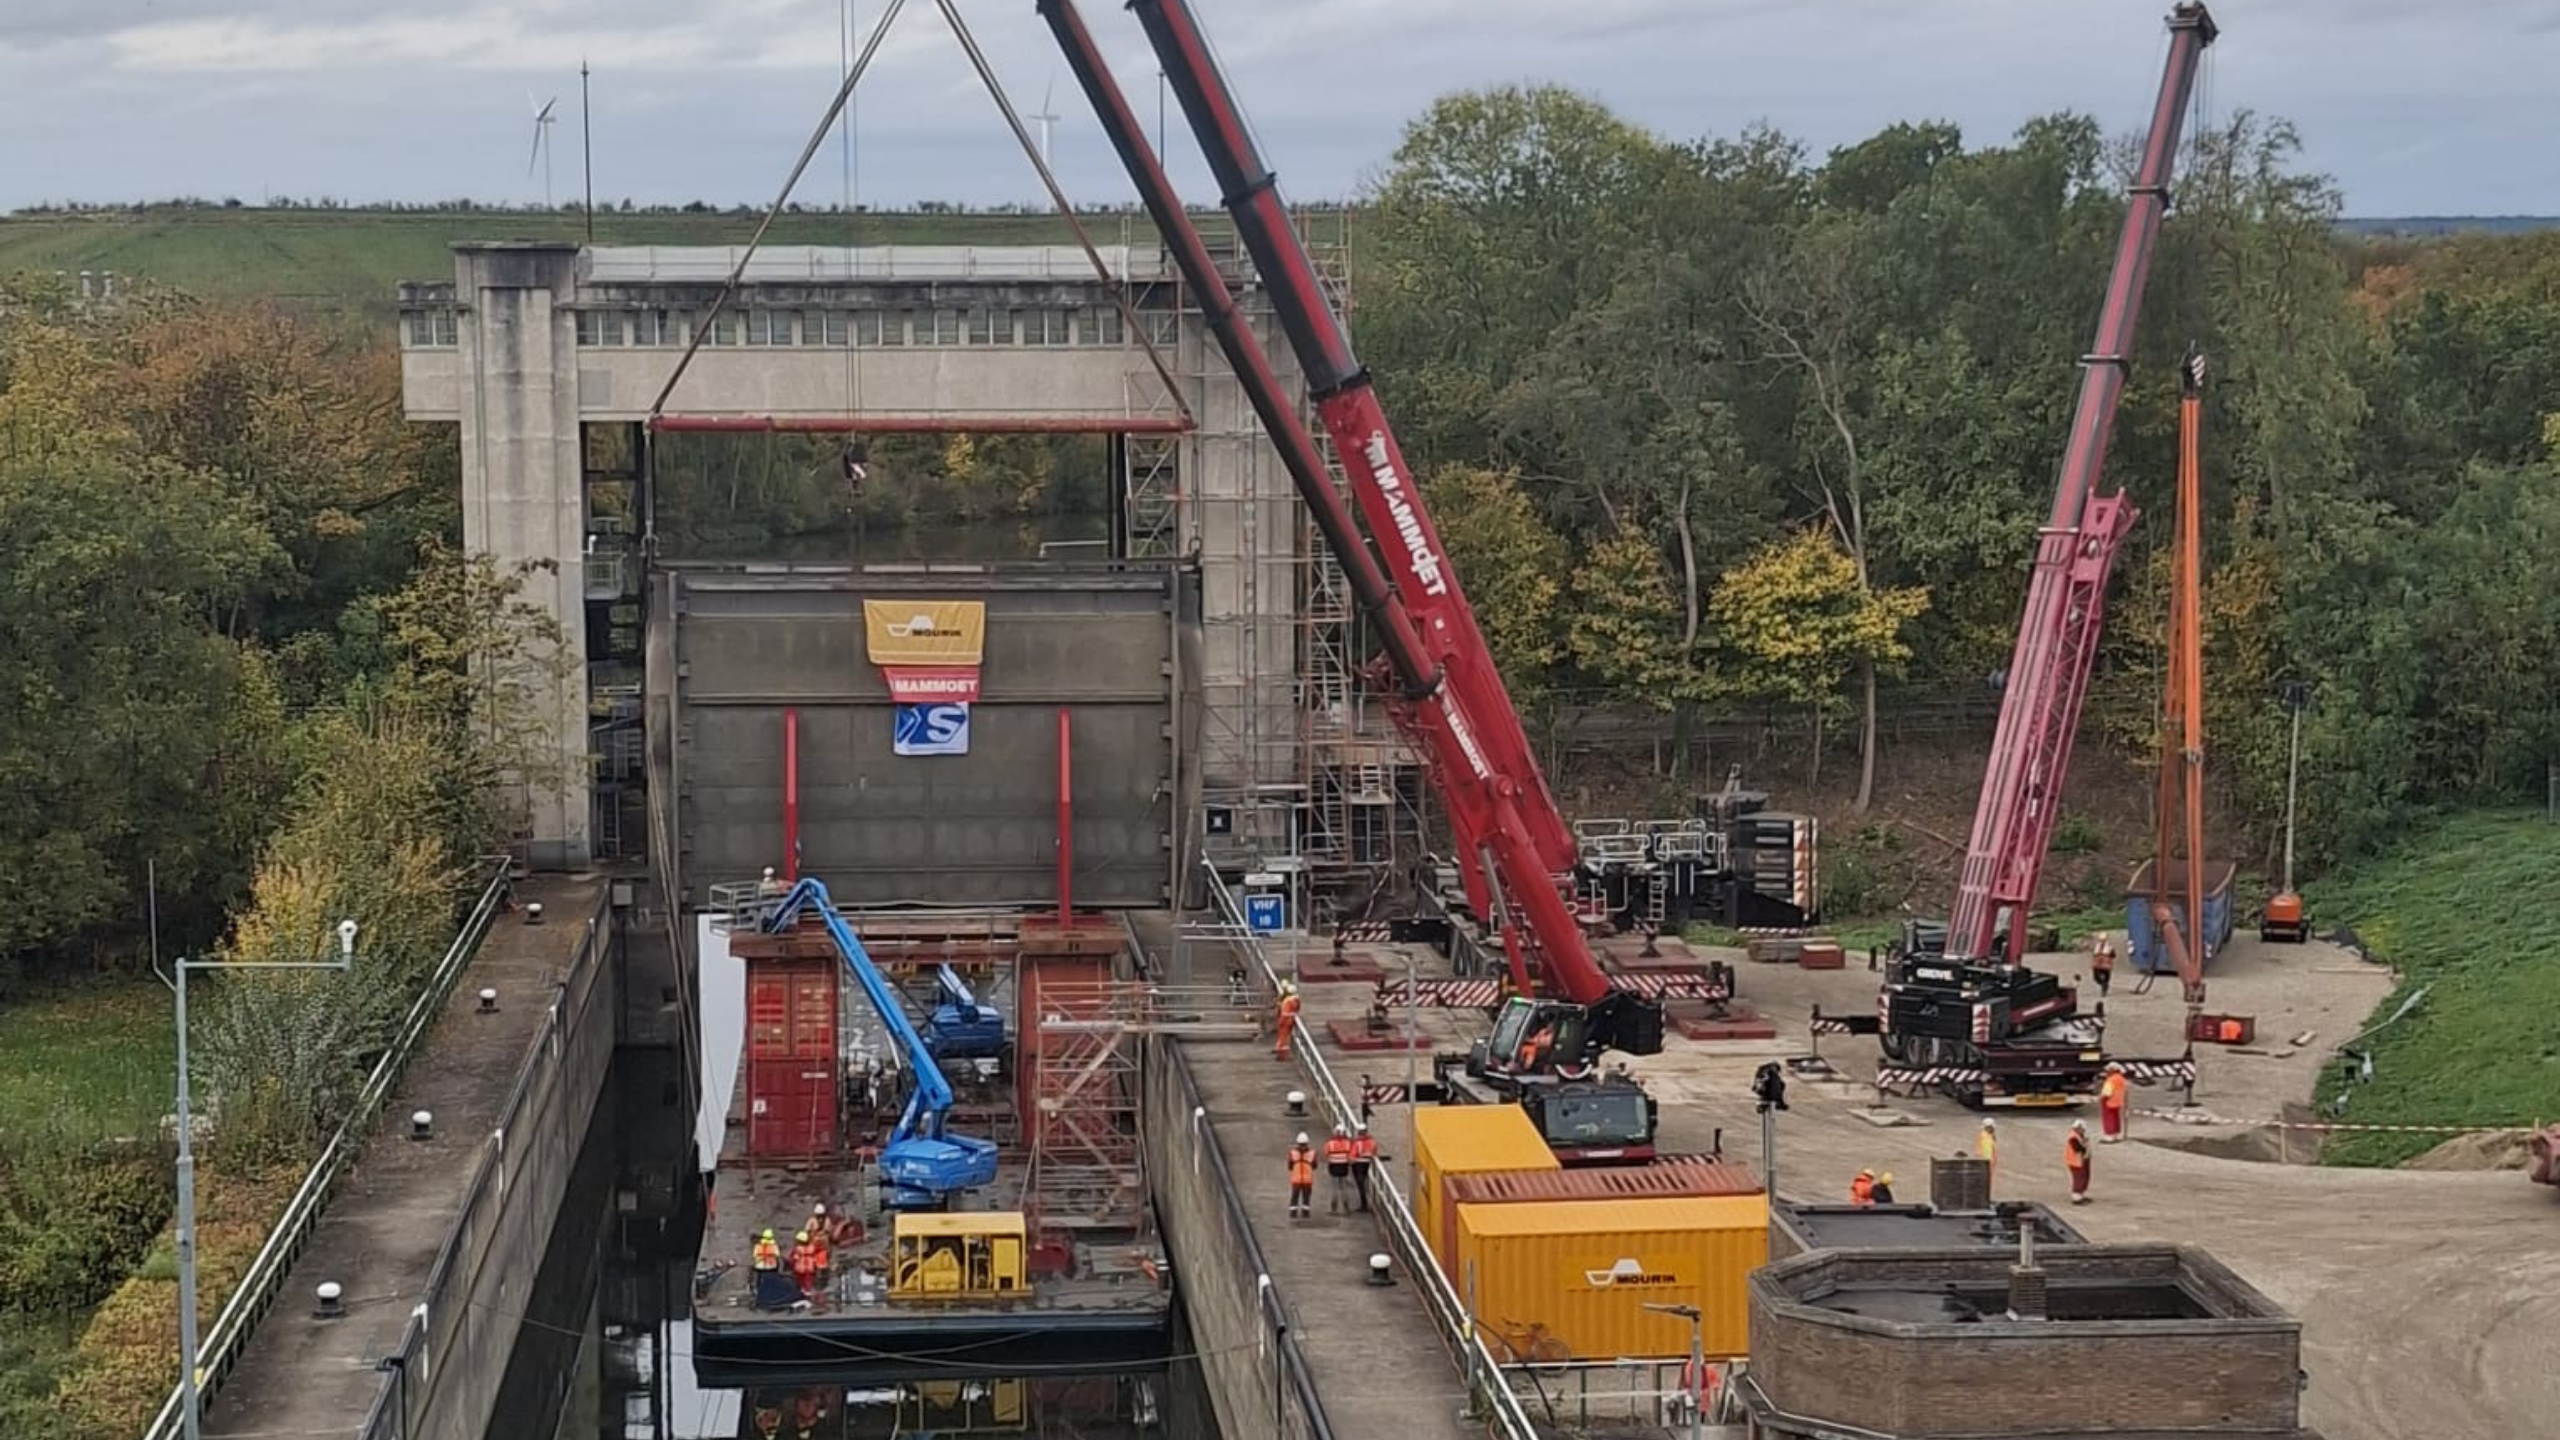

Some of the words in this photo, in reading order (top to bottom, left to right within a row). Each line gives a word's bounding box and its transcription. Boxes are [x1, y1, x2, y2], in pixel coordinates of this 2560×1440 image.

[1373, 465, 1447, 597] MAMMOET
[895, 679, 978, 693] MAMMOET
[1252, 899, 1277, 911] VHF
[1616, 1274, 1677, 1285] MOURIK
